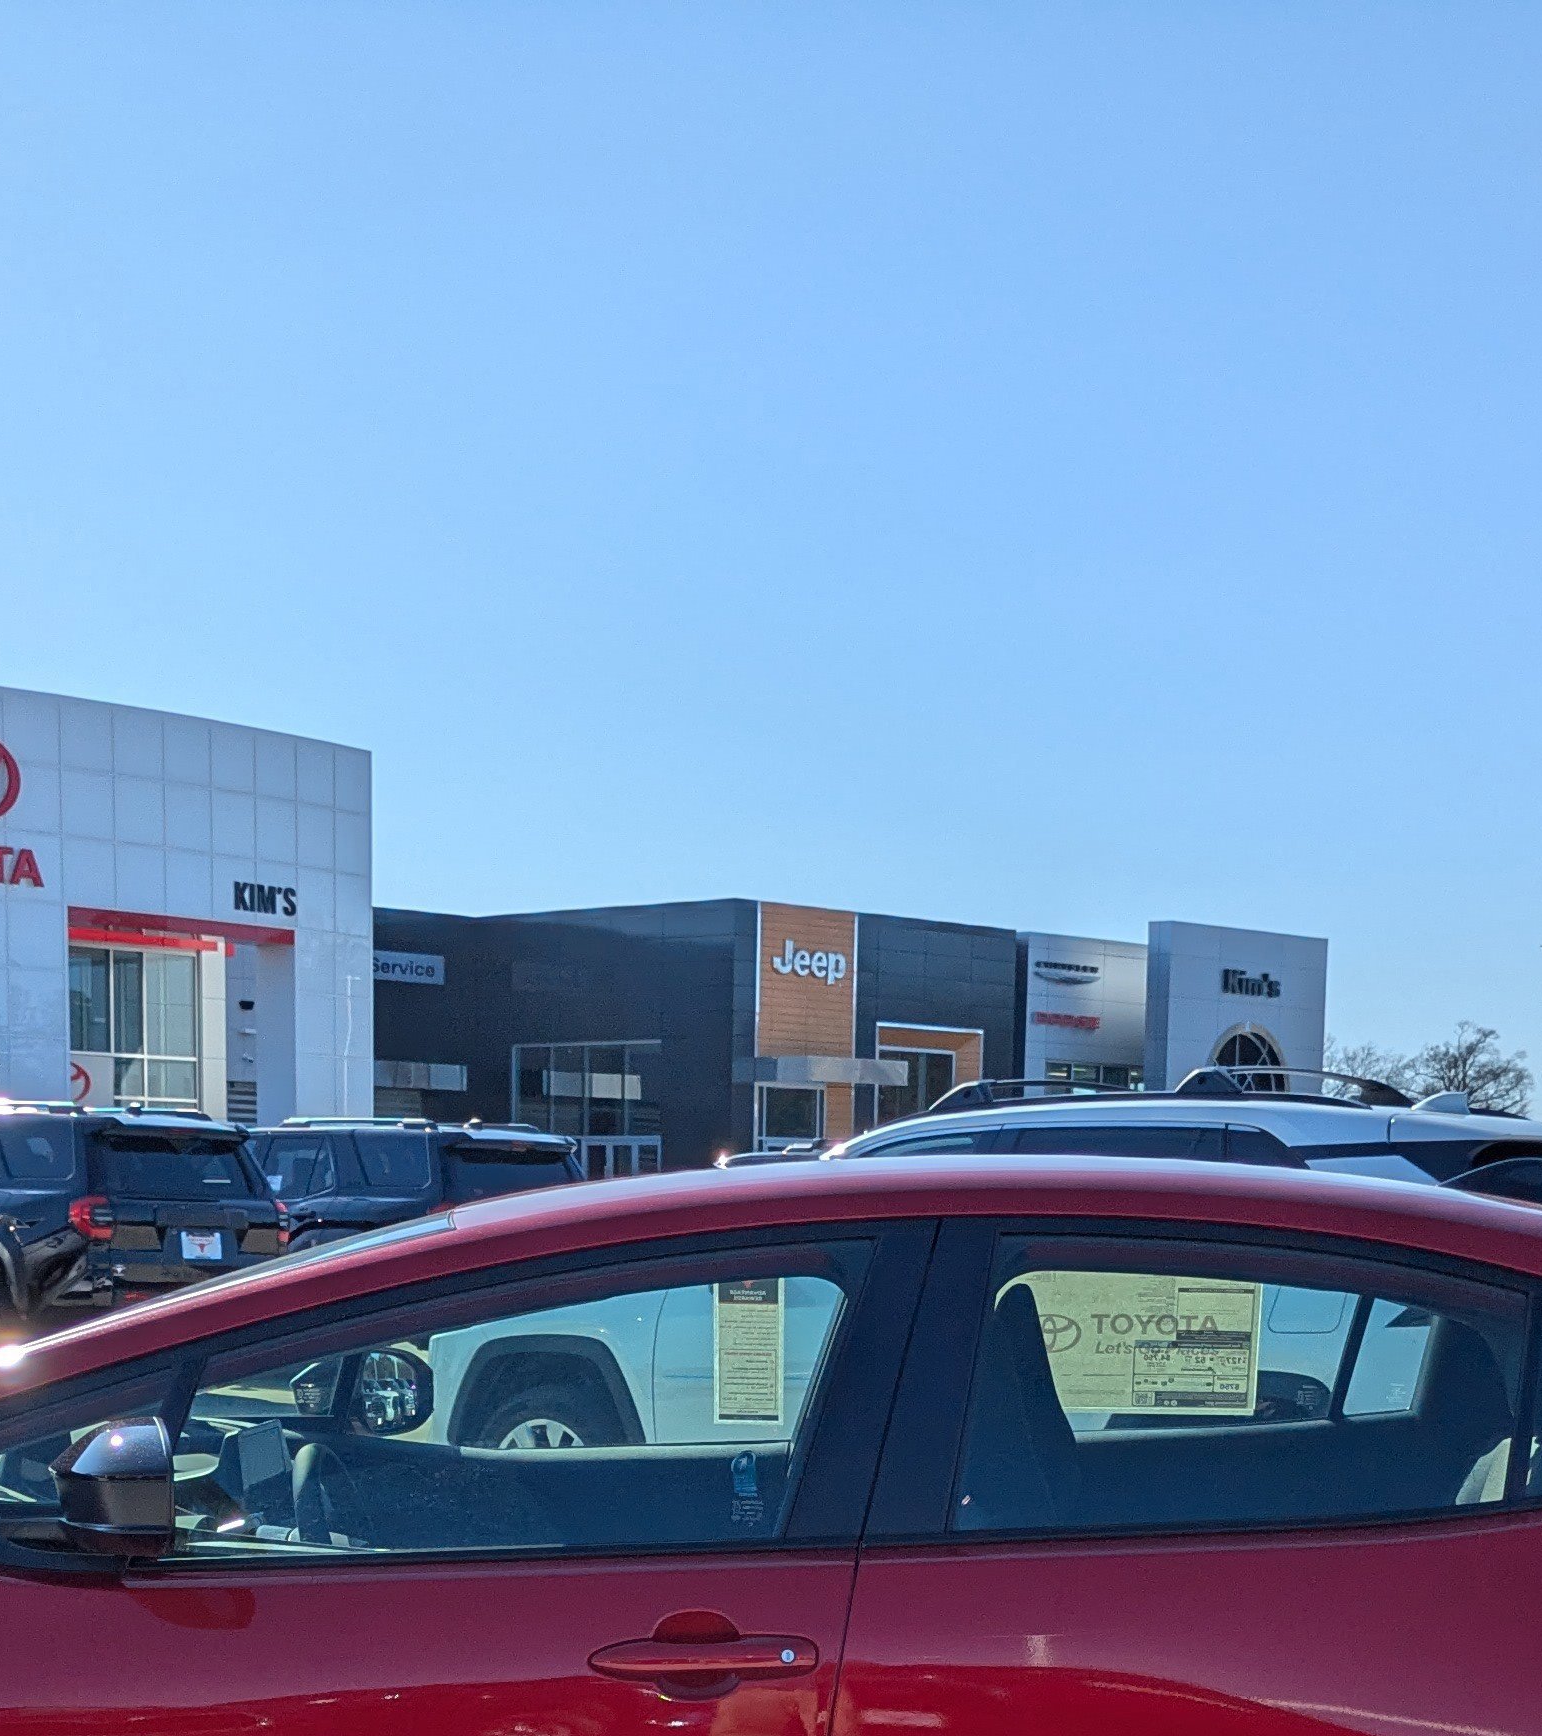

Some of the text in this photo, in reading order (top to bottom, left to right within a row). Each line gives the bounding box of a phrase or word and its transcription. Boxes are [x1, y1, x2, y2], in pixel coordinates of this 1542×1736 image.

[233, 881, 297, 916] KIM'S
[772, 938, 847, 985] Jeep
[1222, 968, 1281, 998] Kim's
[1091, 1313, 1219, 1335] TOYOTA
[1094, 1341, 1134, 1355] Let's
